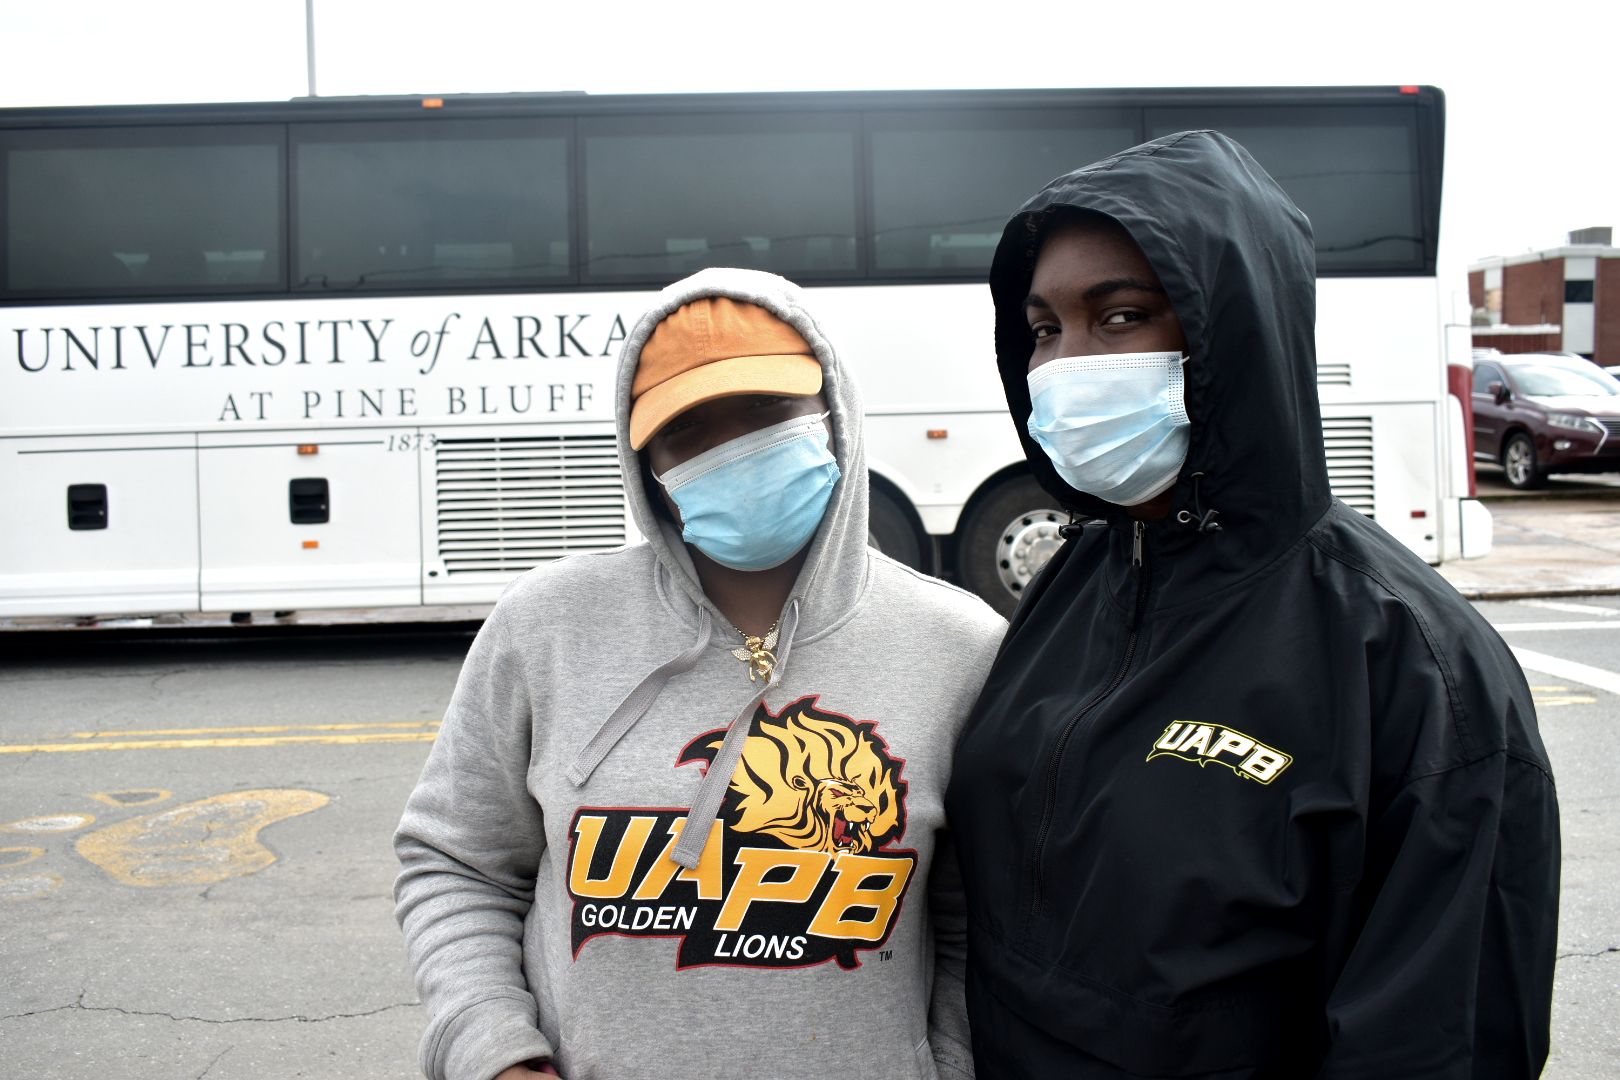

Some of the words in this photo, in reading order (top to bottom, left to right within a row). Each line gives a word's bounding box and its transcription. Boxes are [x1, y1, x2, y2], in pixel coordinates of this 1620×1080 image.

[12, 319, 395, 373] UNIVERSITY
[410, 312, 461, 375] of
[217, 391, 273, 422] AT
[302, 386, 418, 420] PINE
[446, 383, 594, 416] BLUFF
[387, 433, 437, 452] 1873
[1155, 722, 1289, 782] UAPB
[569, 815, 914, 942] UAPB
[581, 904, 698, 930] GOLDEN
[714, 934, 808, 960] LIONS
[879, 950, 893, 962] TM
